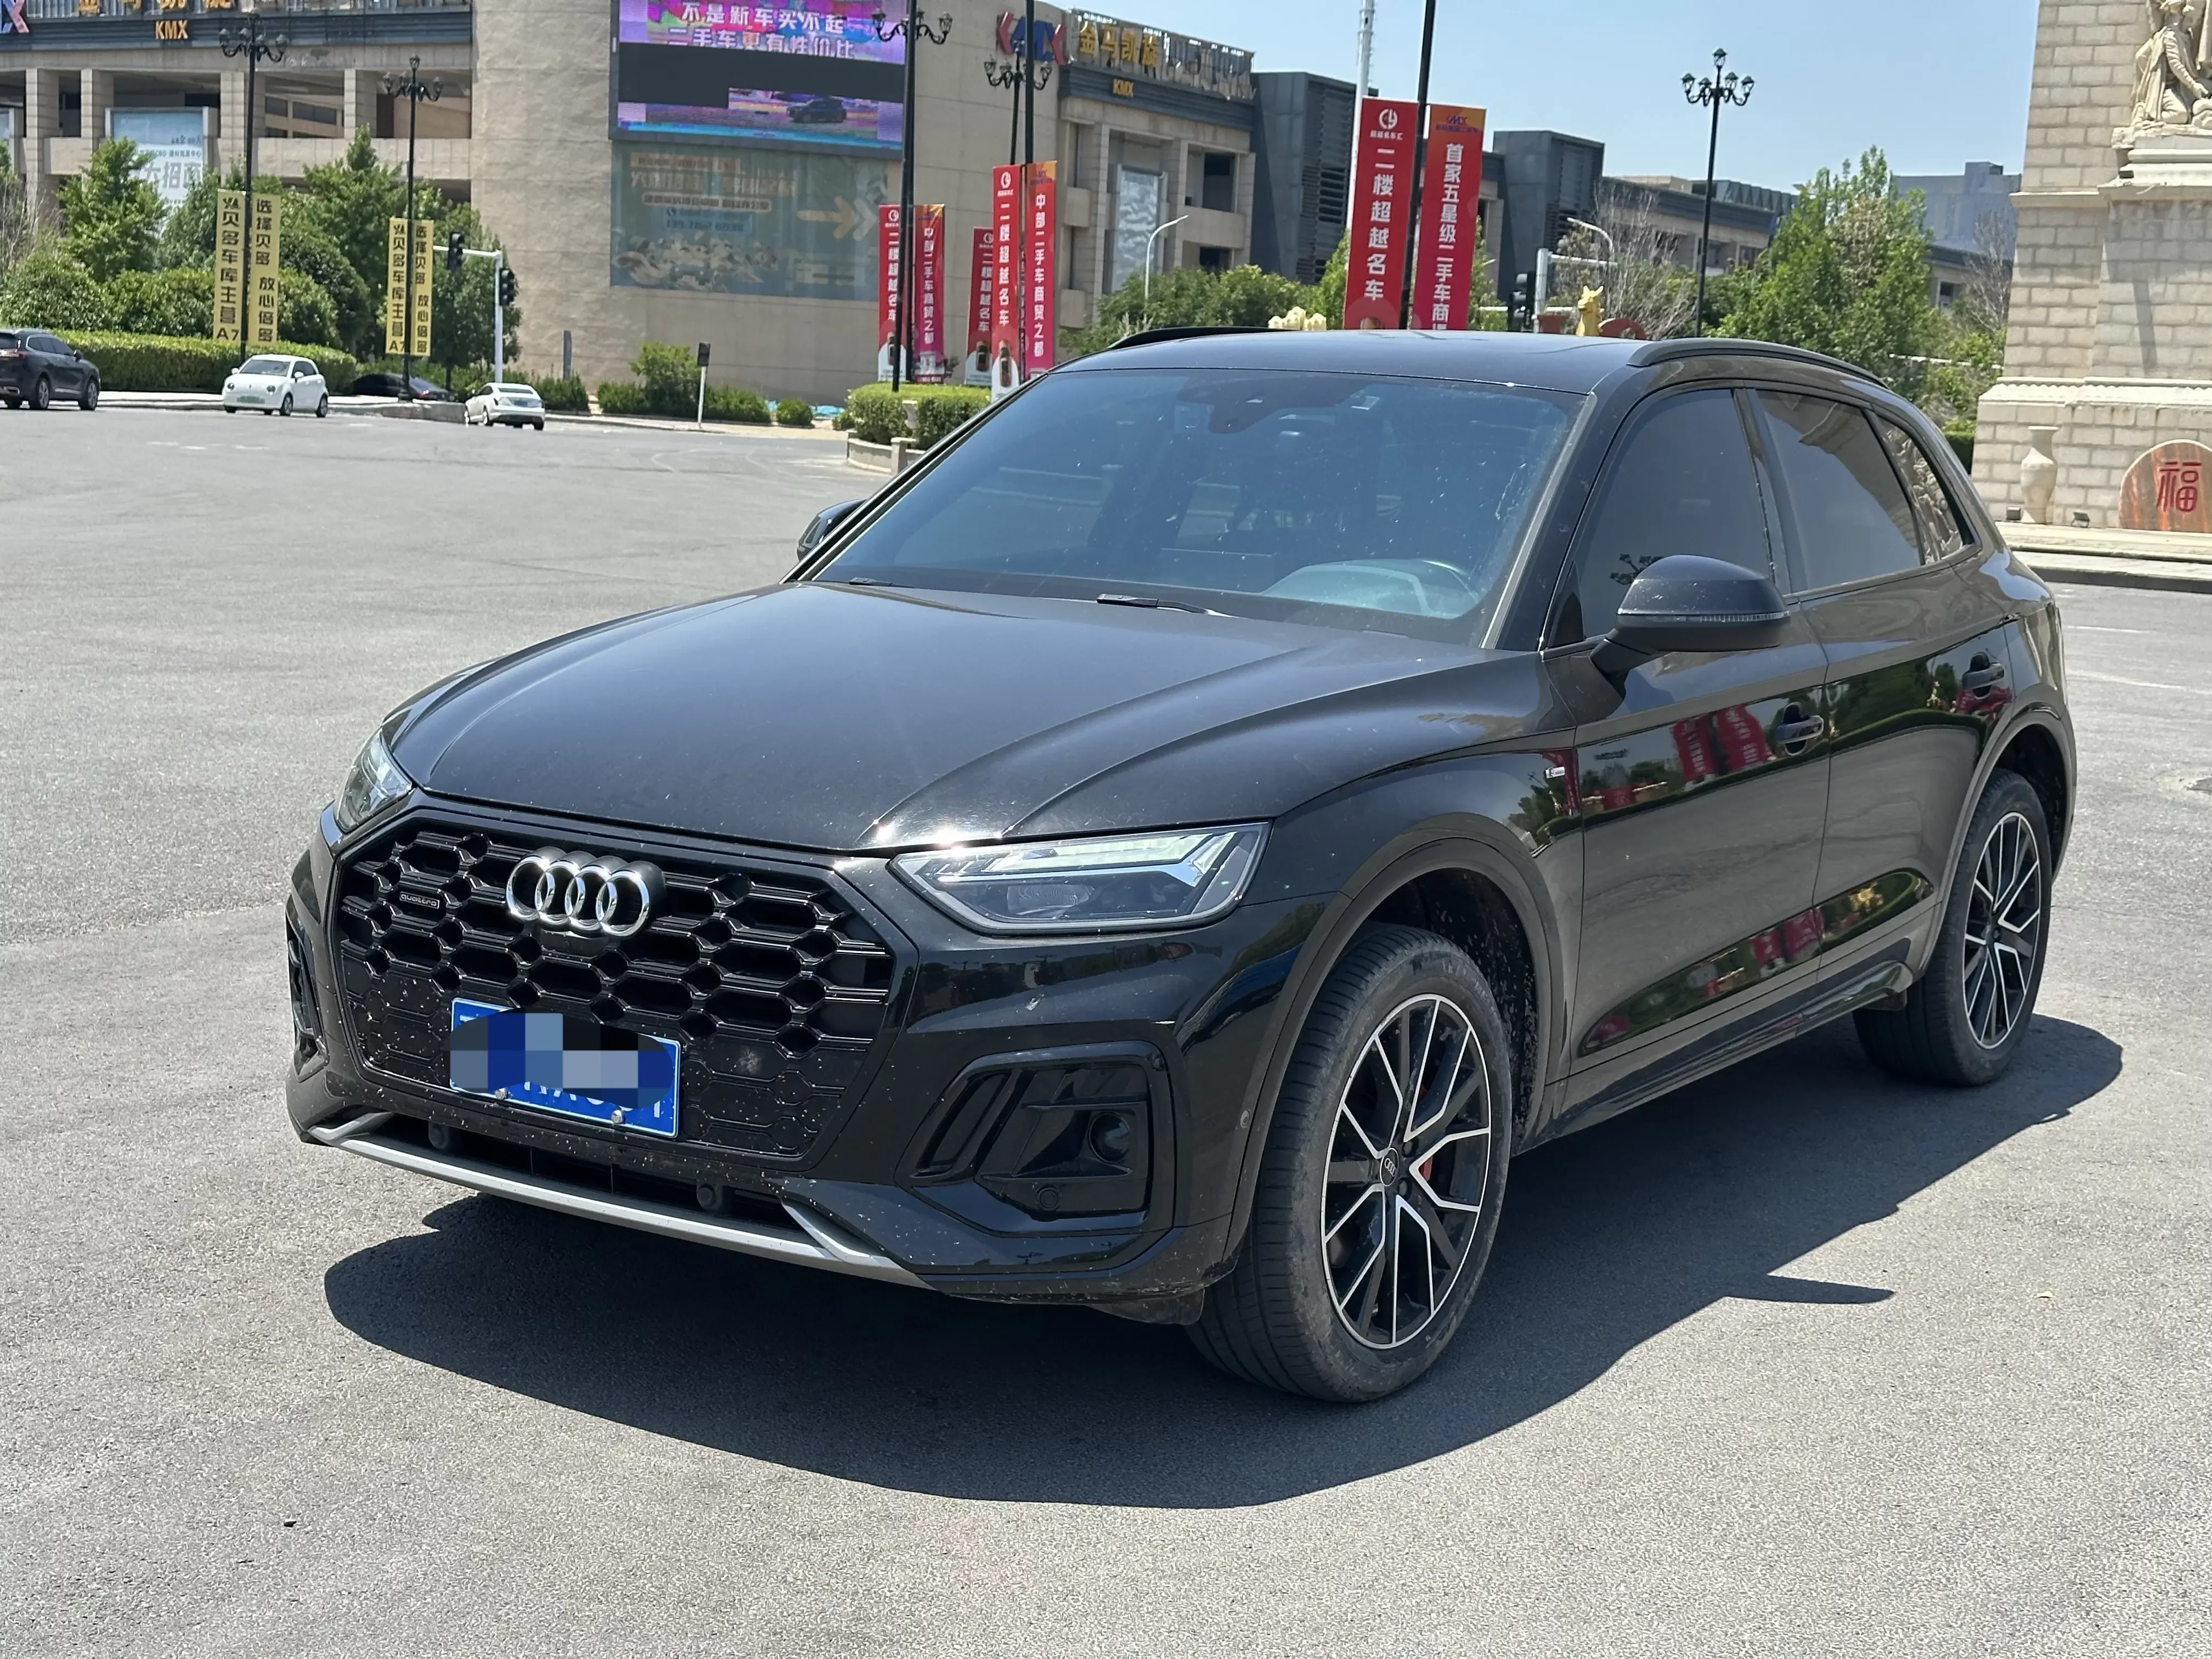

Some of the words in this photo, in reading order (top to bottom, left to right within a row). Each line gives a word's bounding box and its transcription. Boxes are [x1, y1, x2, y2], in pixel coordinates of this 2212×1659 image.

[155, 20, 188, 40] KMX
[681, 2, 844, 33] 不是新车买不起
[668, 27, 855, 59] 二手车更有性价比
[1079, 20, 1159, 67] 金马凯旋
[1113, 78, 1134, 97] KMX
[1364, 148, 1395, 301] 二楼超越名车
[998, 203, 1010, 326] 二楼超越名车
[2156, 460, 2202, 513] 福
[400, 894, 437, 907] quattro
